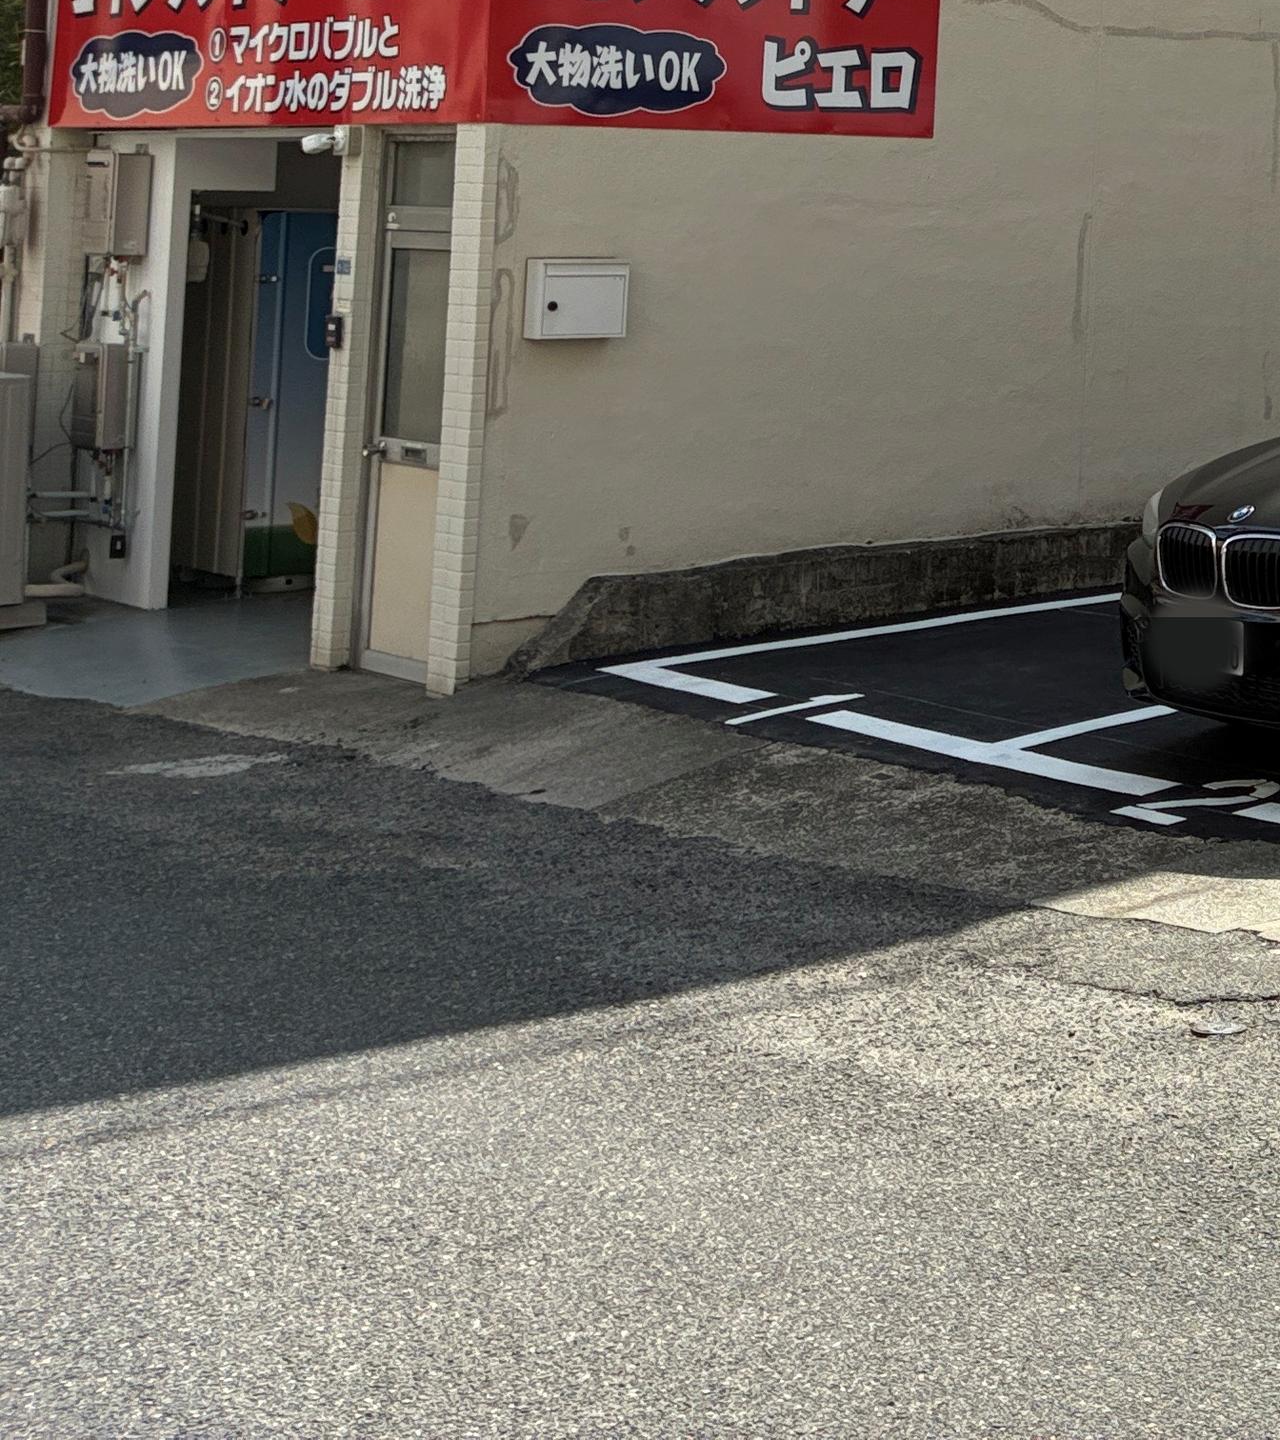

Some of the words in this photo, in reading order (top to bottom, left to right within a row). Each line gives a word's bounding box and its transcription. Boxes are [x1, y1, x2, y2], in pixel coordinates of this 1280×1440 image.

[78, 50, 188, 95] 大物洗いOK
[525, 41, 702, 93] 大物洗いOK
[762, 36, 922, 112] ピエロ
[1109, 778, 1280, 825] 2
